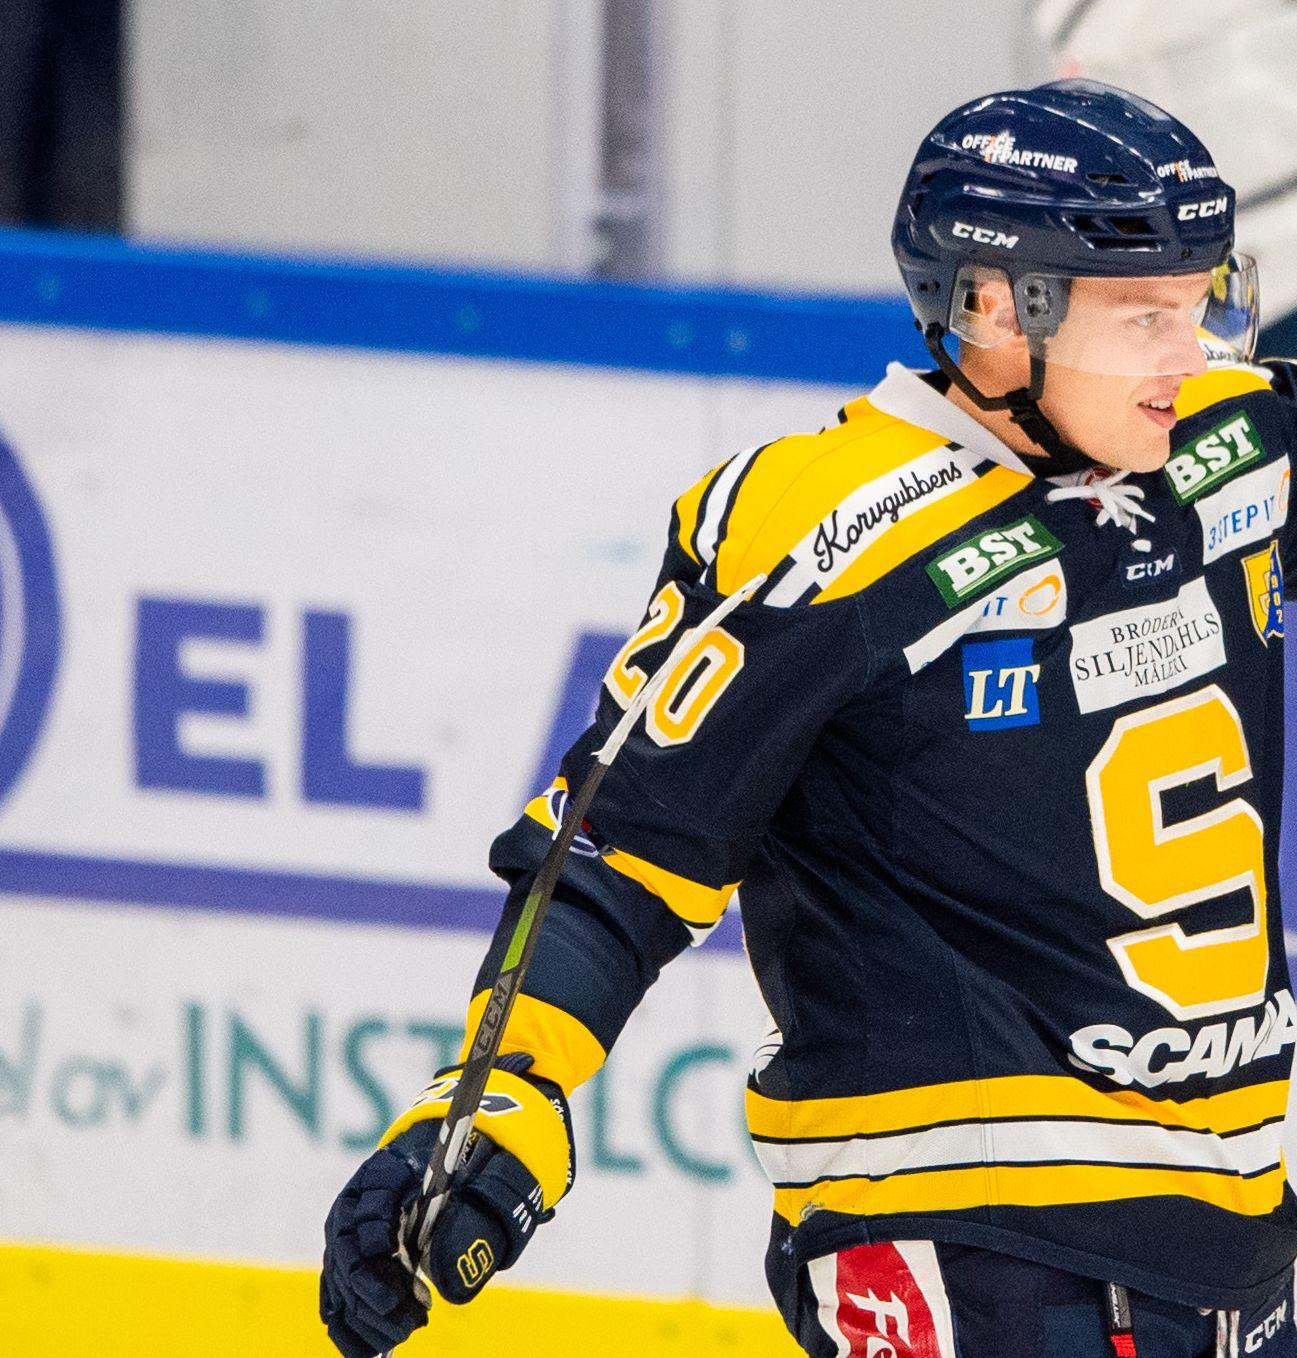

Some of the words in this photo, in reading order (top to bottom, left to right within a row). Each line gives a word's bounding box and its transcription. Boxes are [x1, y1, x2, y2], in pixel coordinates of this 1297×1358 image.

[952, 222, 1019, 249] CCM
[1177, 196, 1227, 221] CCM
[1165, 417, 1254, 494] BST
[813, 461, 962, 573] Korvgubbens
[937, 521, 1036, 593] BST
[982, 597, 1008, 617] IT
[603, 581, 745, 748] 20
[964, 664, 1041, 719] LT
[134, 596, 427, 813] EL
[1086, 683, 1269, 1021] S
[1244, 1299, 1288, 1353] CCM
